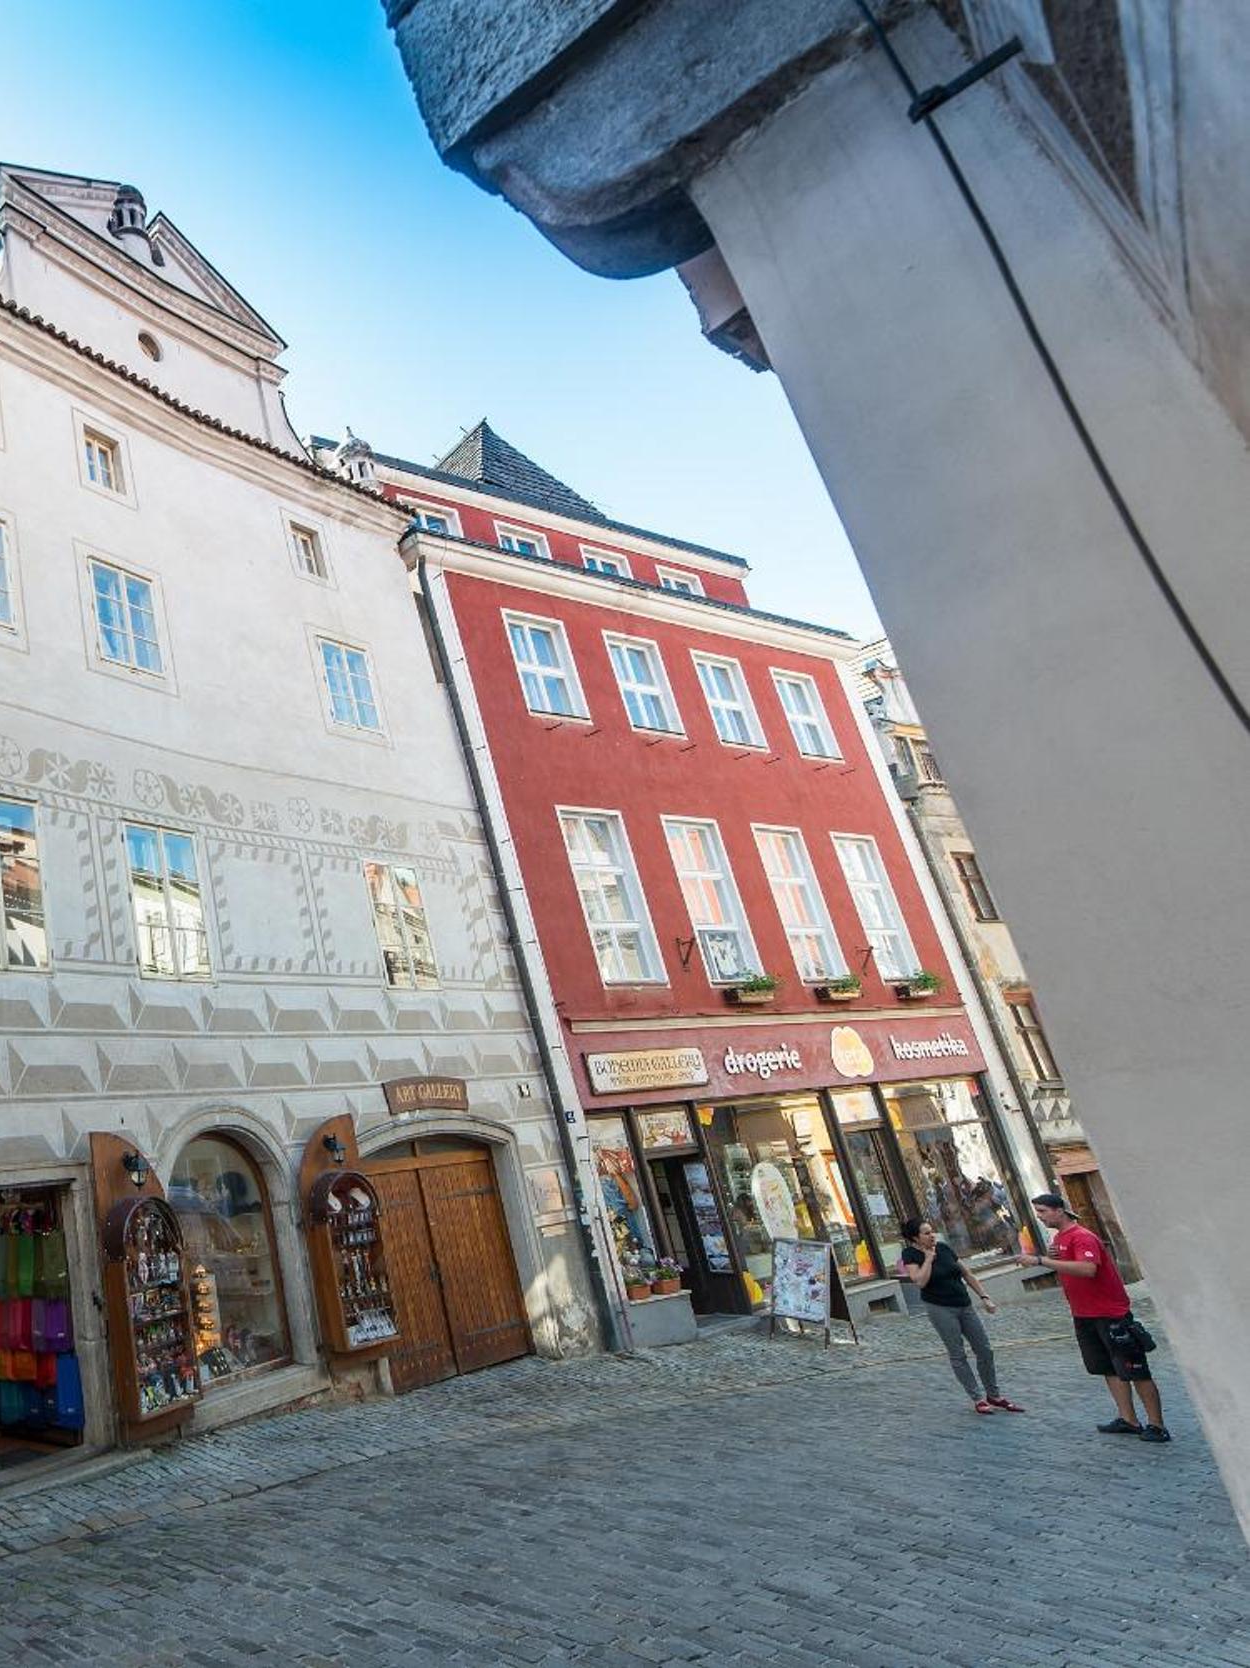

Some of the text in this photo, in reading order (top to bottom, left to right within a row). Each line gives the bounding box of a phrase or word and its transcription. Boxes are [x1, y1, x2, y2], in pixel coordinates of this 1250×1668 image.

[889, 1032, 969, 1060] kosmetika
[724, 1042, 802, 1080] drogerie
[396, 1083, 462, 1103] ART GALLERY
